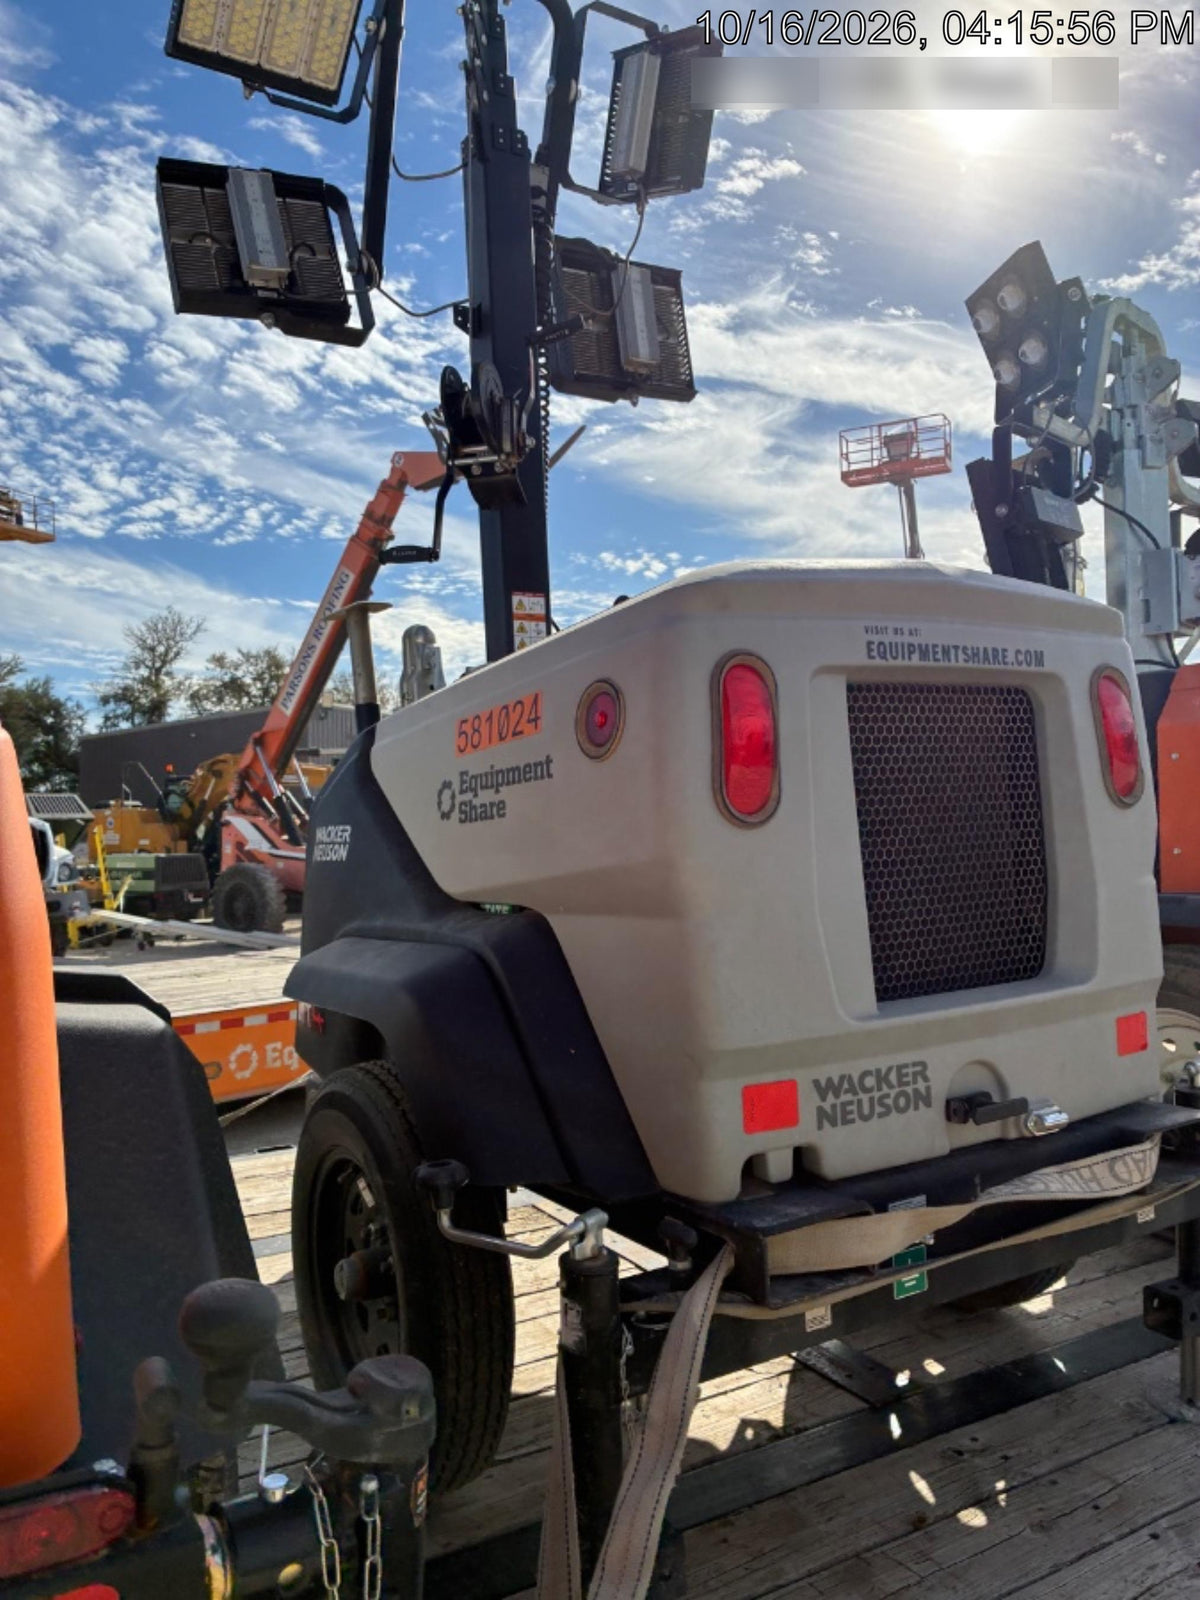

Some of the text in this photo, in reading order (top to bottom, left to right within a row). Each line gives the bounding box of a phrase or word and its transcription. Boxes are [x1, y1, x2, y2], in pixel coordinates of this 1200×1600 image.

[280, 571, 350, 712] PARSONS ROOFING
[866, 640, 1045, 668] EQUIPMENTSHARE.COM
[457, 692, 542, 754] 581024
[459, 754, 554, 798] Equipment
[458, 799, 507, 824] Share
[312, 843, 349, 863] NEUSON
[315, 825, 352, 843] WACKER
[812, 1060, 931, 1102] WACKER
[815, 1085, 933, 1131] NEUSON
